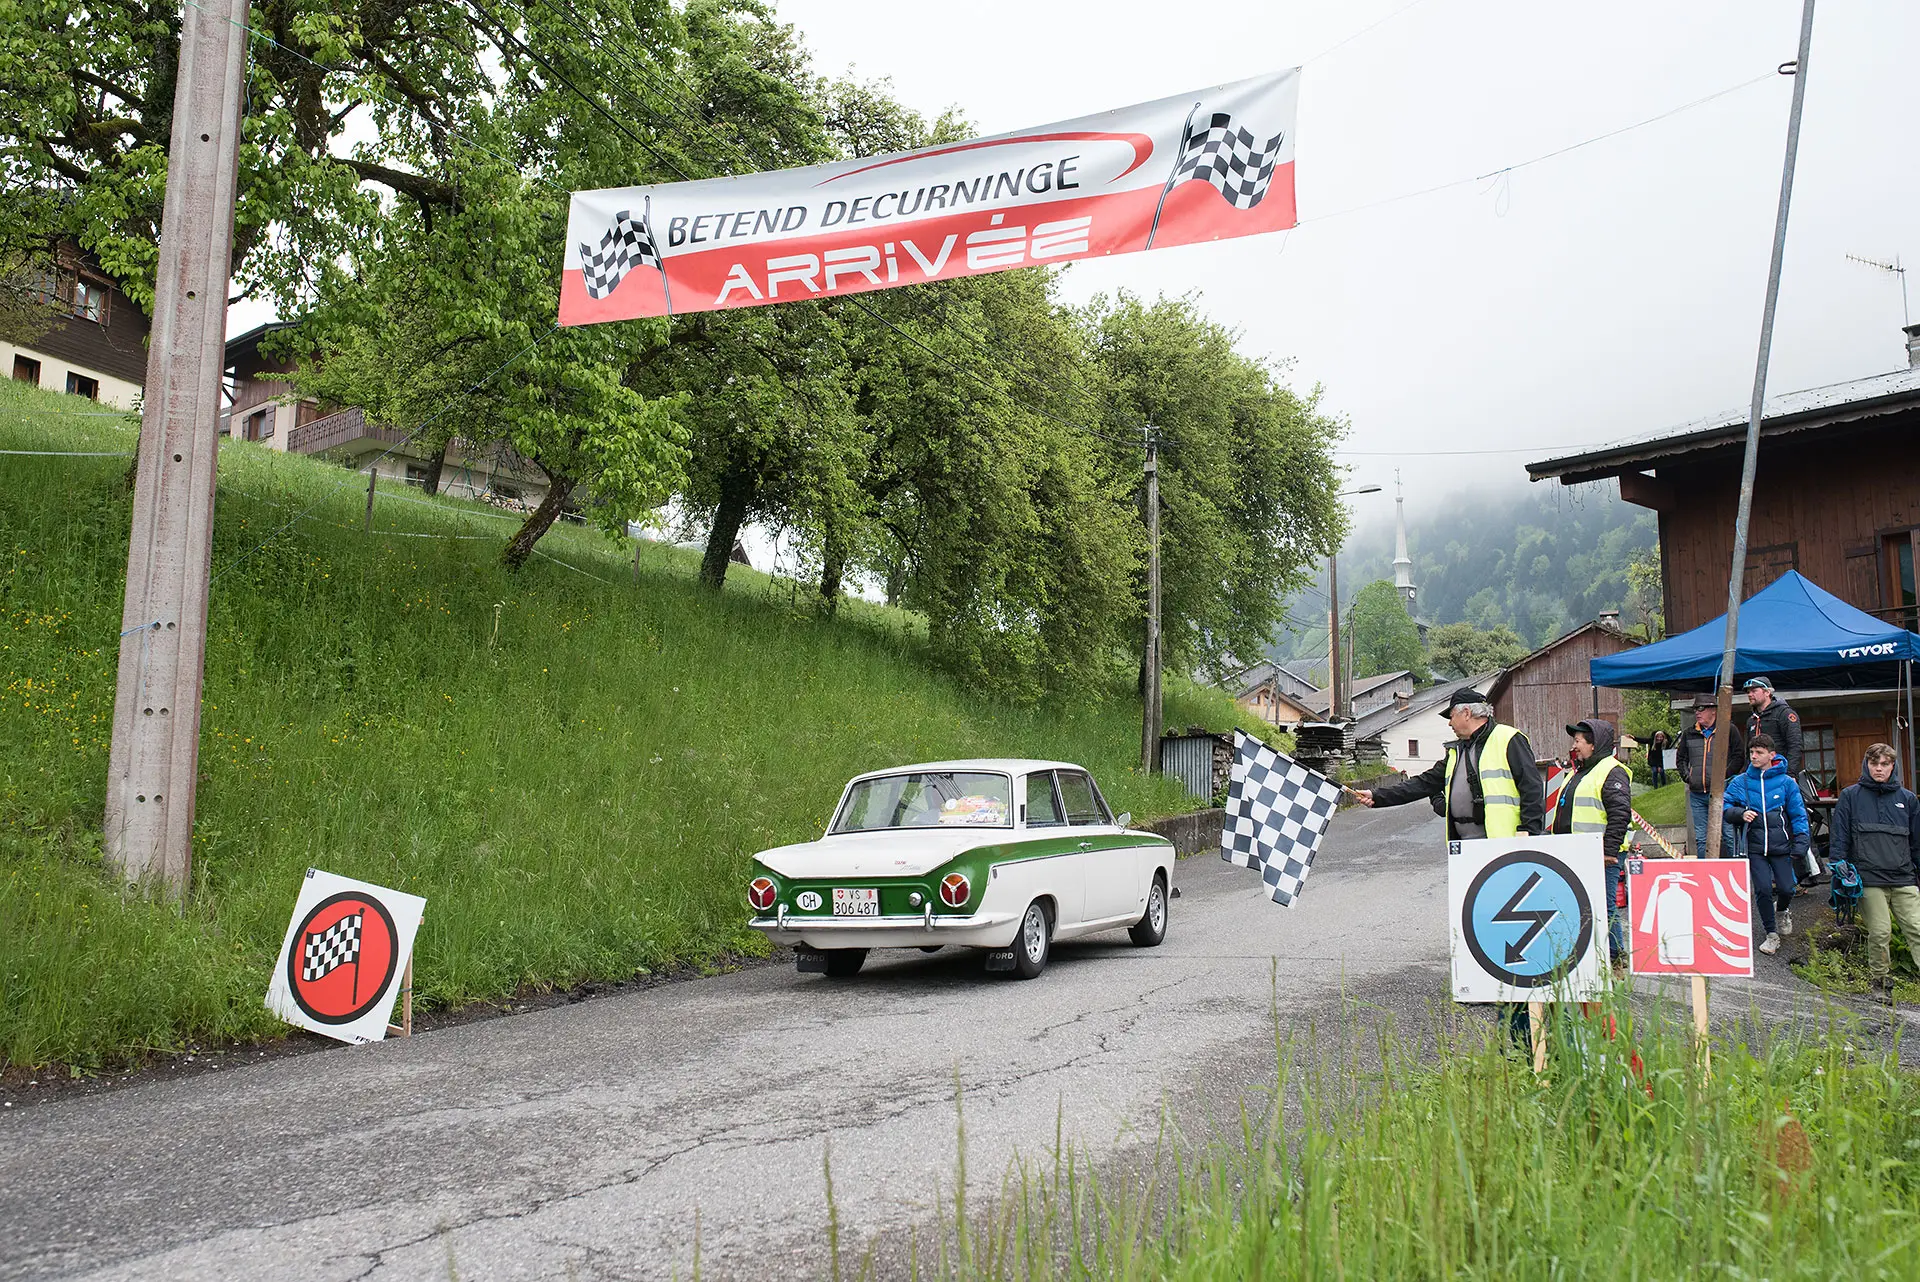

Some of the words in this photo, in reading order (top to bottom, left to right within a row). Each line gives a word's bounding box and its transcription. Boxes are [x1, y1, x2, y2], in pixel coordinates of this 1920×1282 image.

[668, 206, 807, 248] BETEND
[820, 155, 1081, 228] DECURNINGE
[1838, 643, 1895, 658] VEVOR
[802, 894, 817, 908] CH
[848, 890, 861, 900] VS
[834, 902, 855, 915] 306
[857, 902, 877, 915] 487
[800, 953, 826, 962] FORD
[989, 951, 1014, 960] FORD
